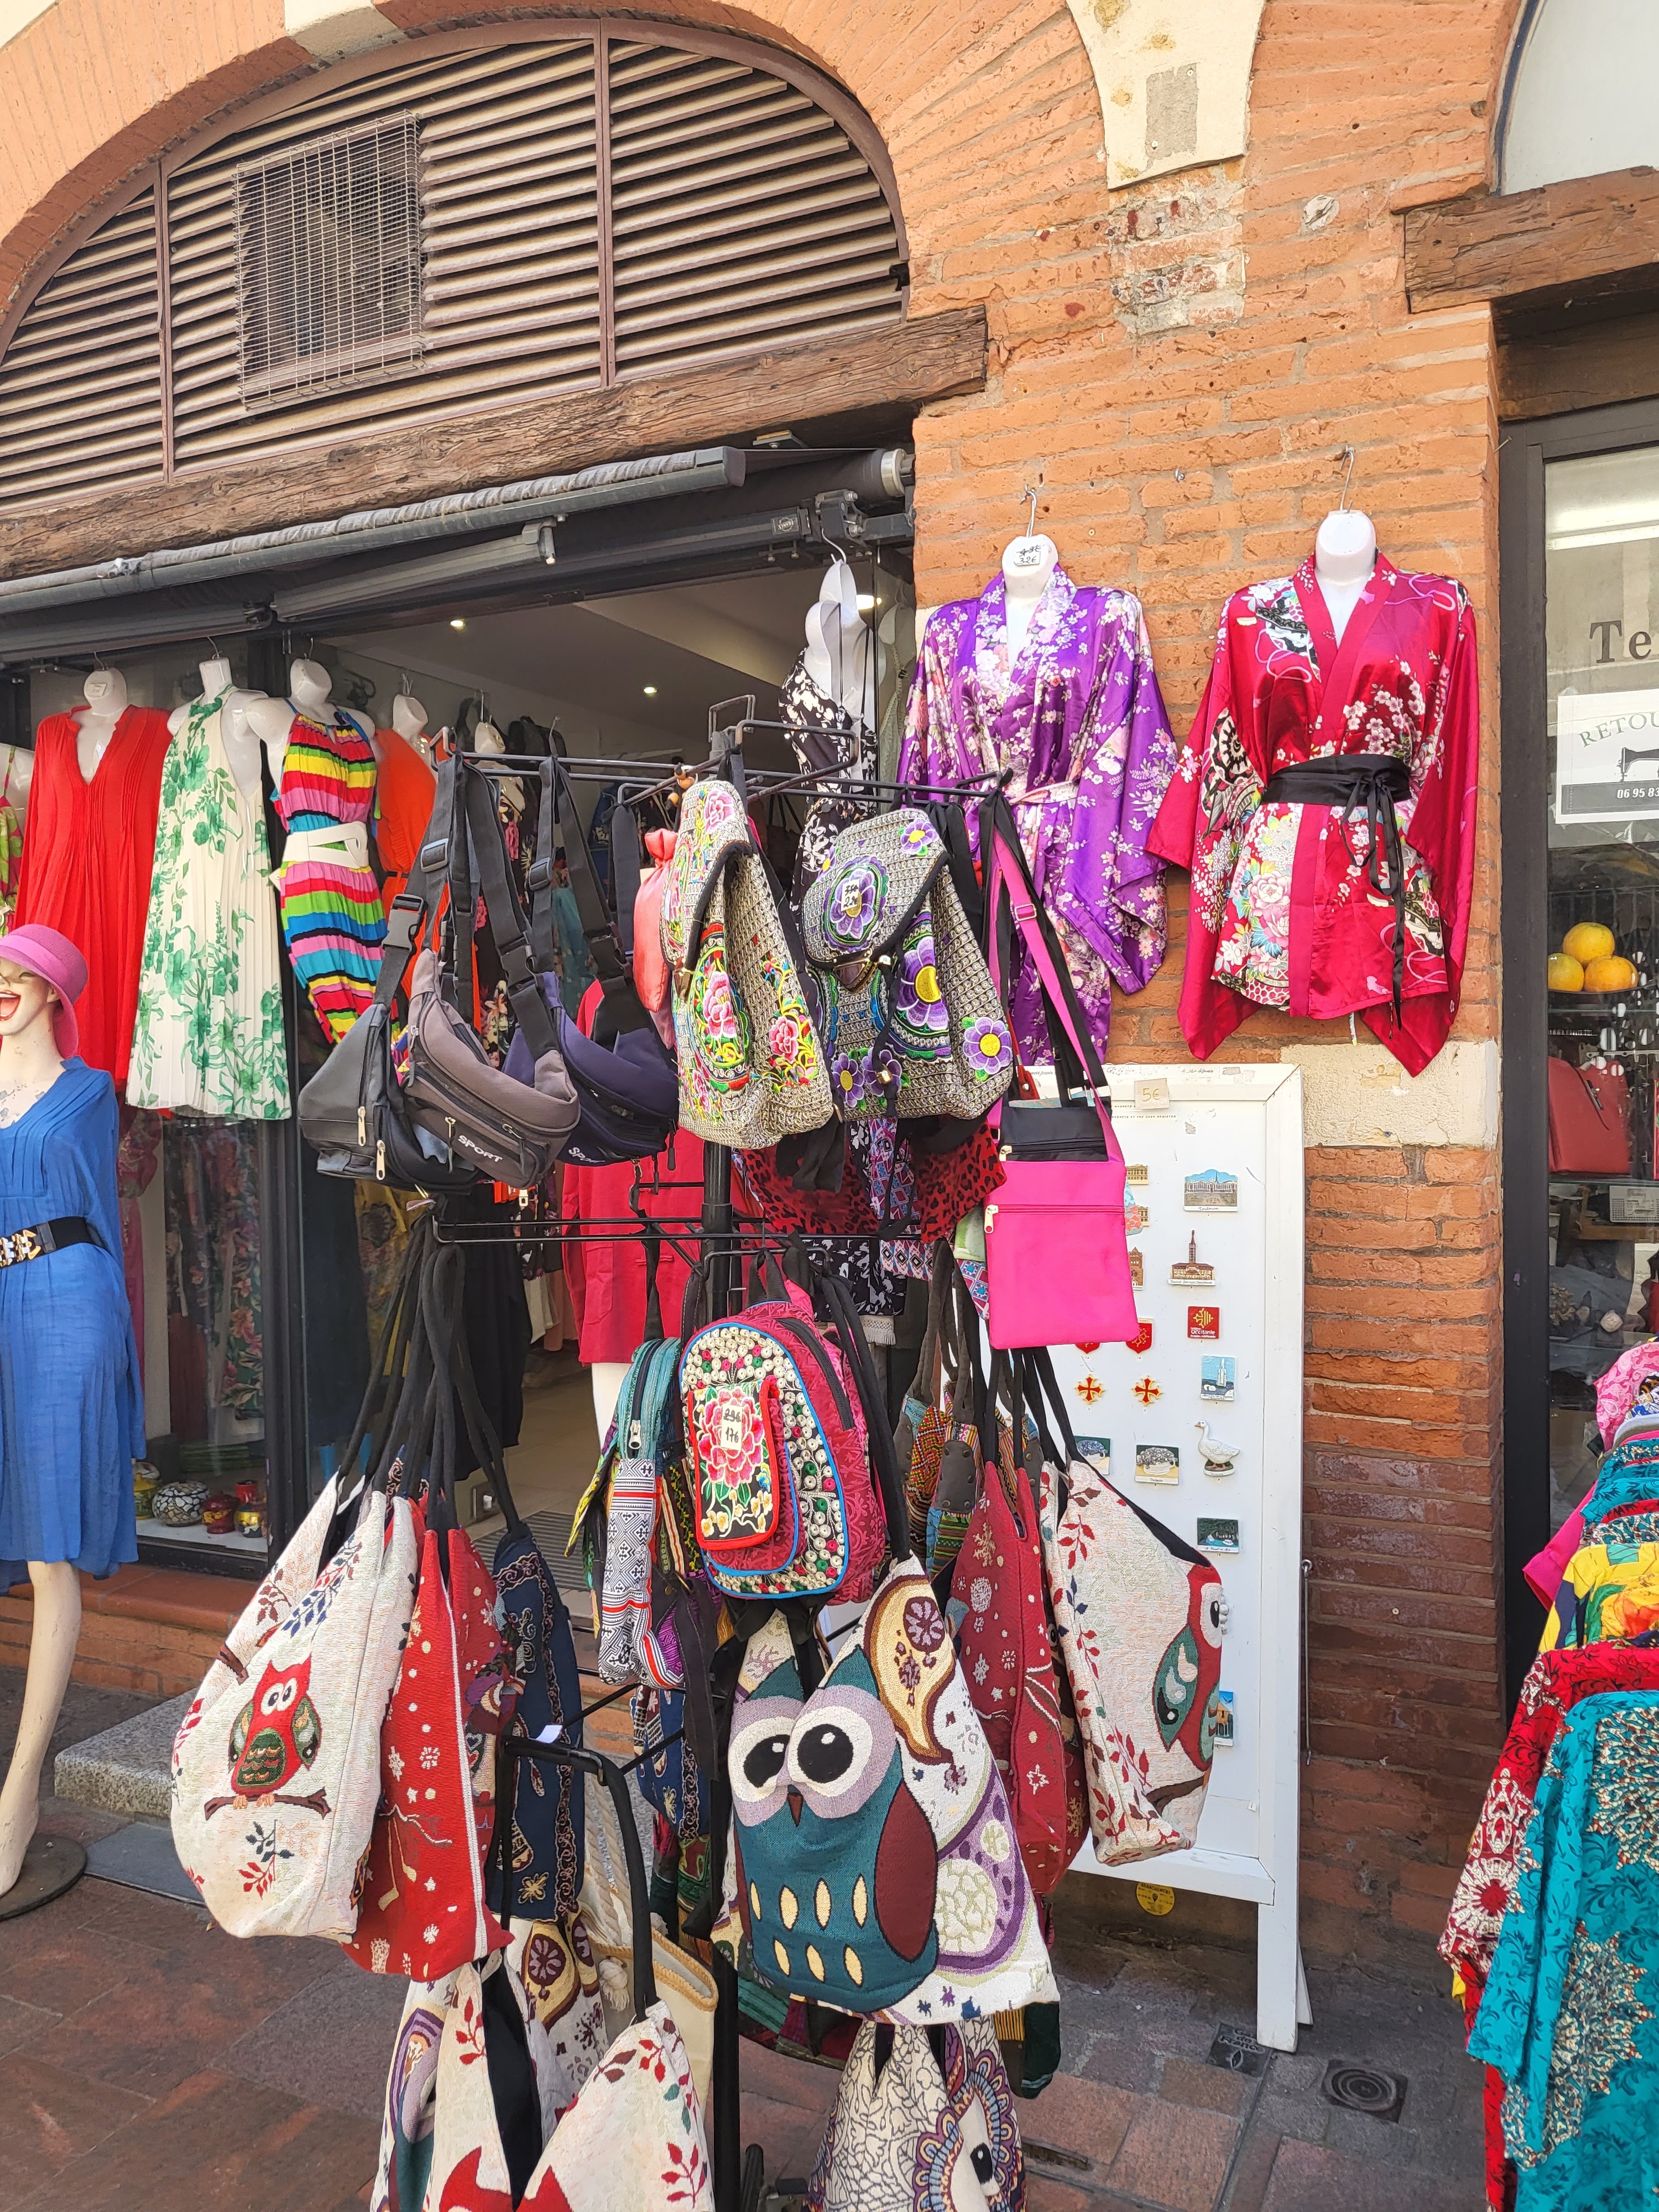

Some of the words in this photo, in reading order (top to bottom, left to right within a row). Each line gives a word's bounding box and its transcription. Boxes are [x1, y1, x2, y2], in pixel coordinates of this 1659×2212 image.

[1616, 789, 1630, 799] 06
[1632, 788, 1646, 798] 95
[1142, 1088, 1160, 1102] 5€
[458, 1135, 503, 1162] SPORT
